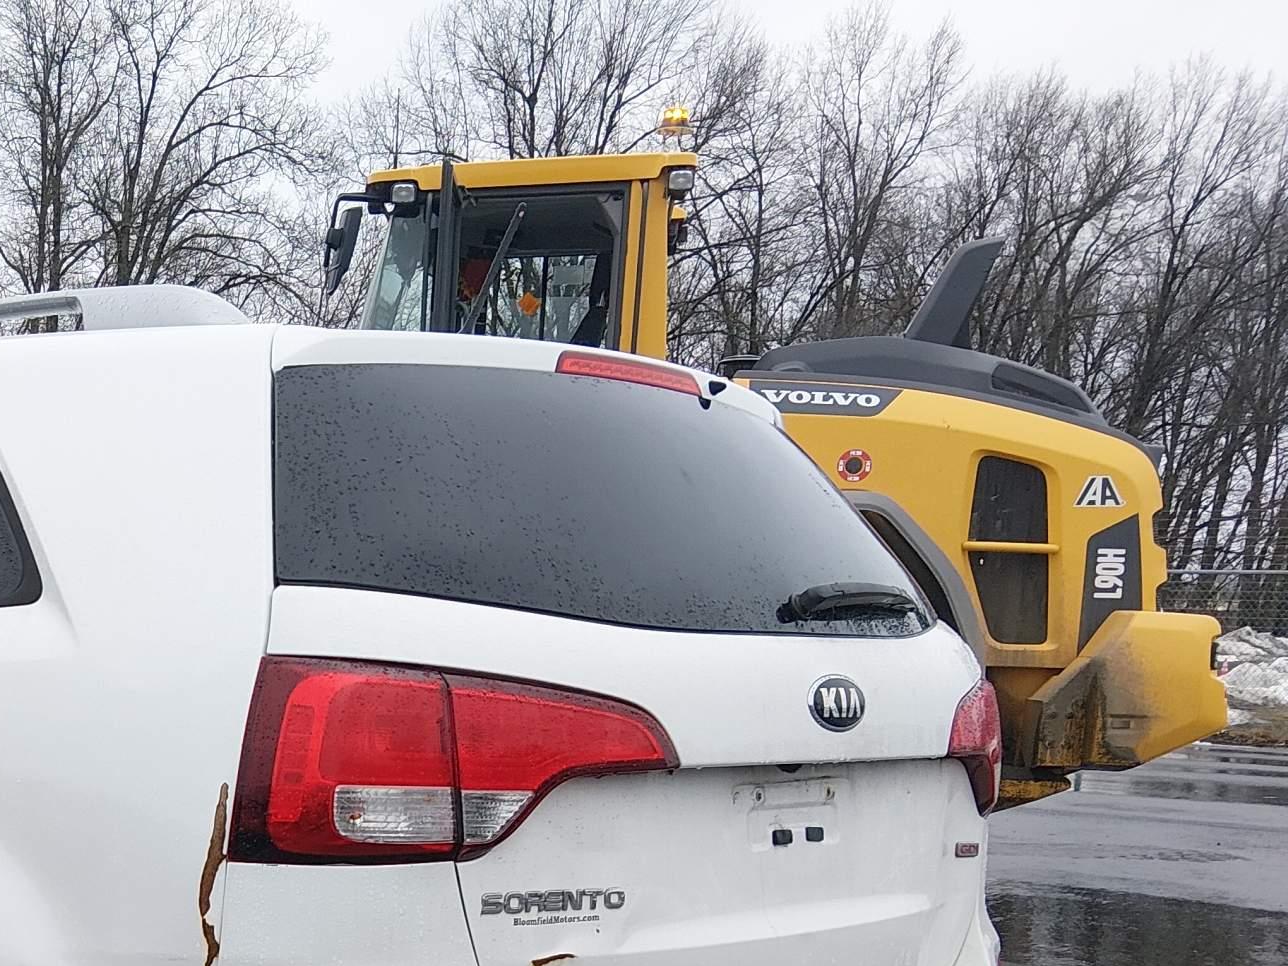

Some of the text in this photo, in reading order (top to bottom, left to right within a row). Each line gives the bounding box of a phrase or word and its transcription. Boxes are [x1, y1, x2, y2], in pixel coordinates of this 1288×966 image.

[760, 388, 881, 408] VOLVO
[1092, 547, 1127, 600] L90H
[819, 687, 862, 719] KIA
[480, 887, 626, 916] SORENTO
[513, 914, 600, 926] BloomfieldMotors.com
